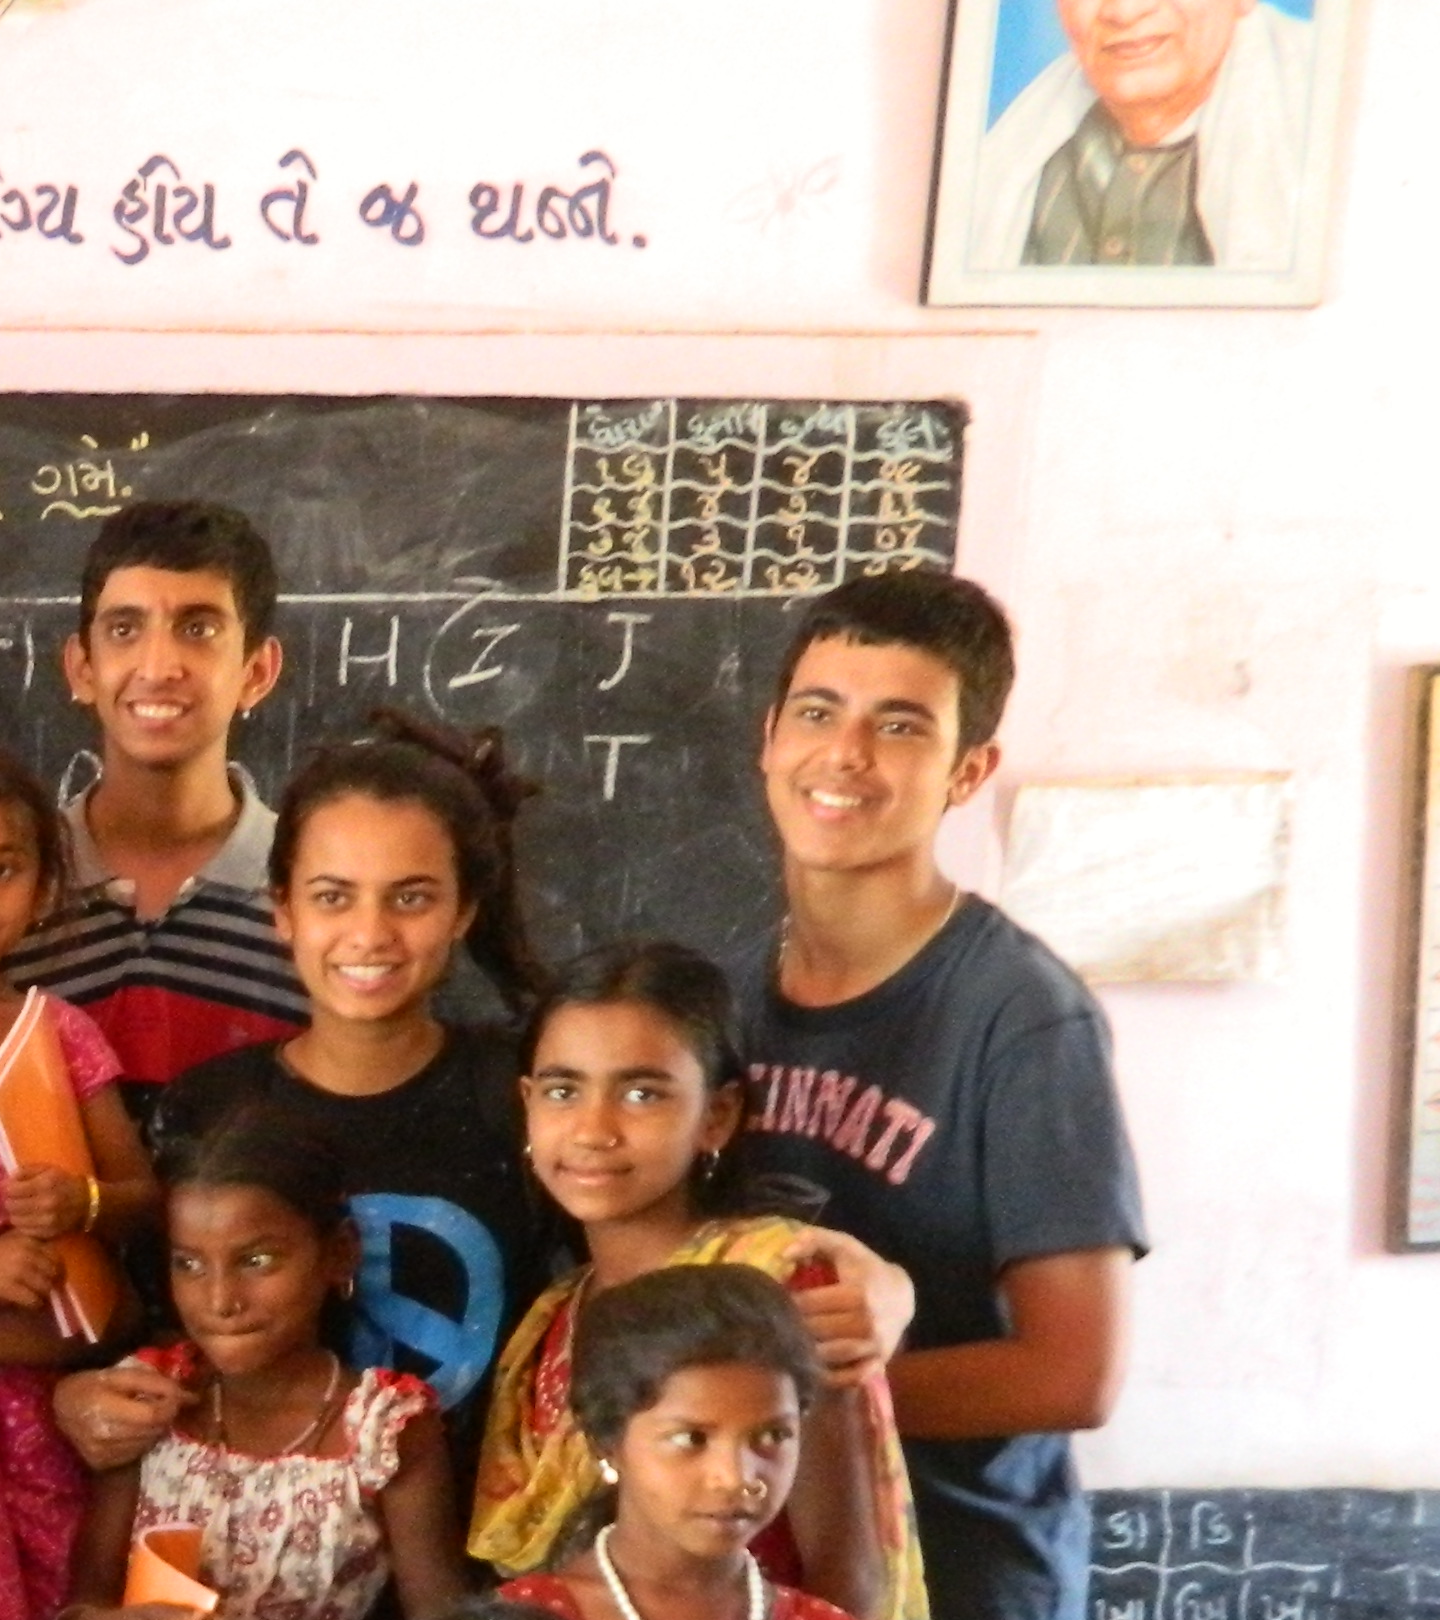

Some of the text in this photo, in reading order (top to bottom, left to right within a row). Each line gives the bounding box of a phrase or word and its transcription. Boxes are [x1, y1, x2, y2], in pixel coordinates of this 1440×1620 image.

[260, 149, 321, 245] તે
[359, 183, 426, 246] જ
[337, 616, 401, 688] H
[598, 612, 654, 691] J
[583, 734, 654, 800] T
[742, 1062, 937, 1186] INNATI
